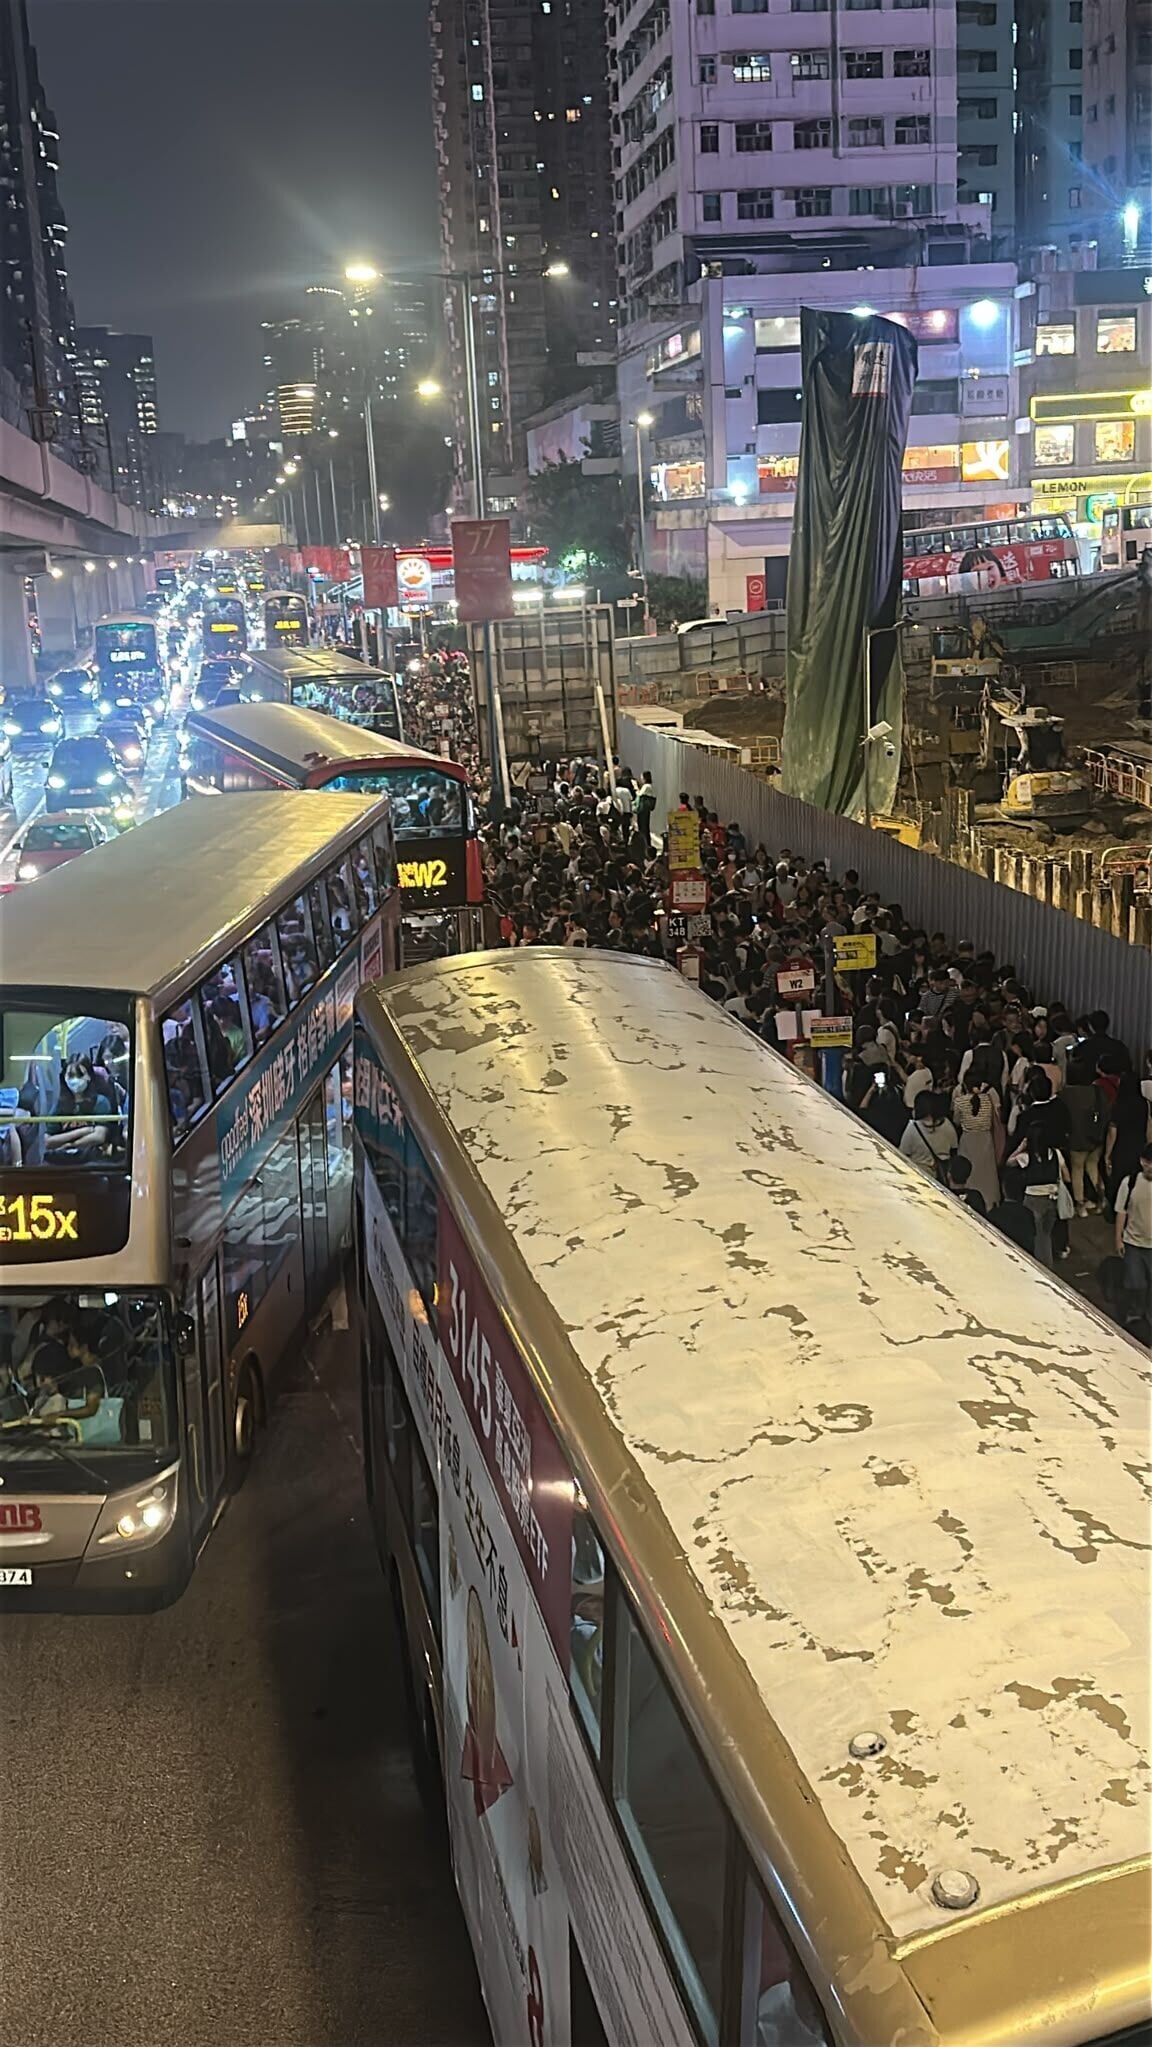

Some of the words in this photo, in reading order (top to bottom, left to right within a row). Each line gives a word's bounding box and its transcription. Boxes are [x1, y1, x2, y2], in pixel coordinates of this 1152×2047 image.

[1042, 482, 1087, 494] LEMON
[669, 917, 685, 927] KT
[789, 979, 803, 990] W2
[450, 1258, 492, 1440] 3145
[464, 1464, 509, 1643] 生生不息
